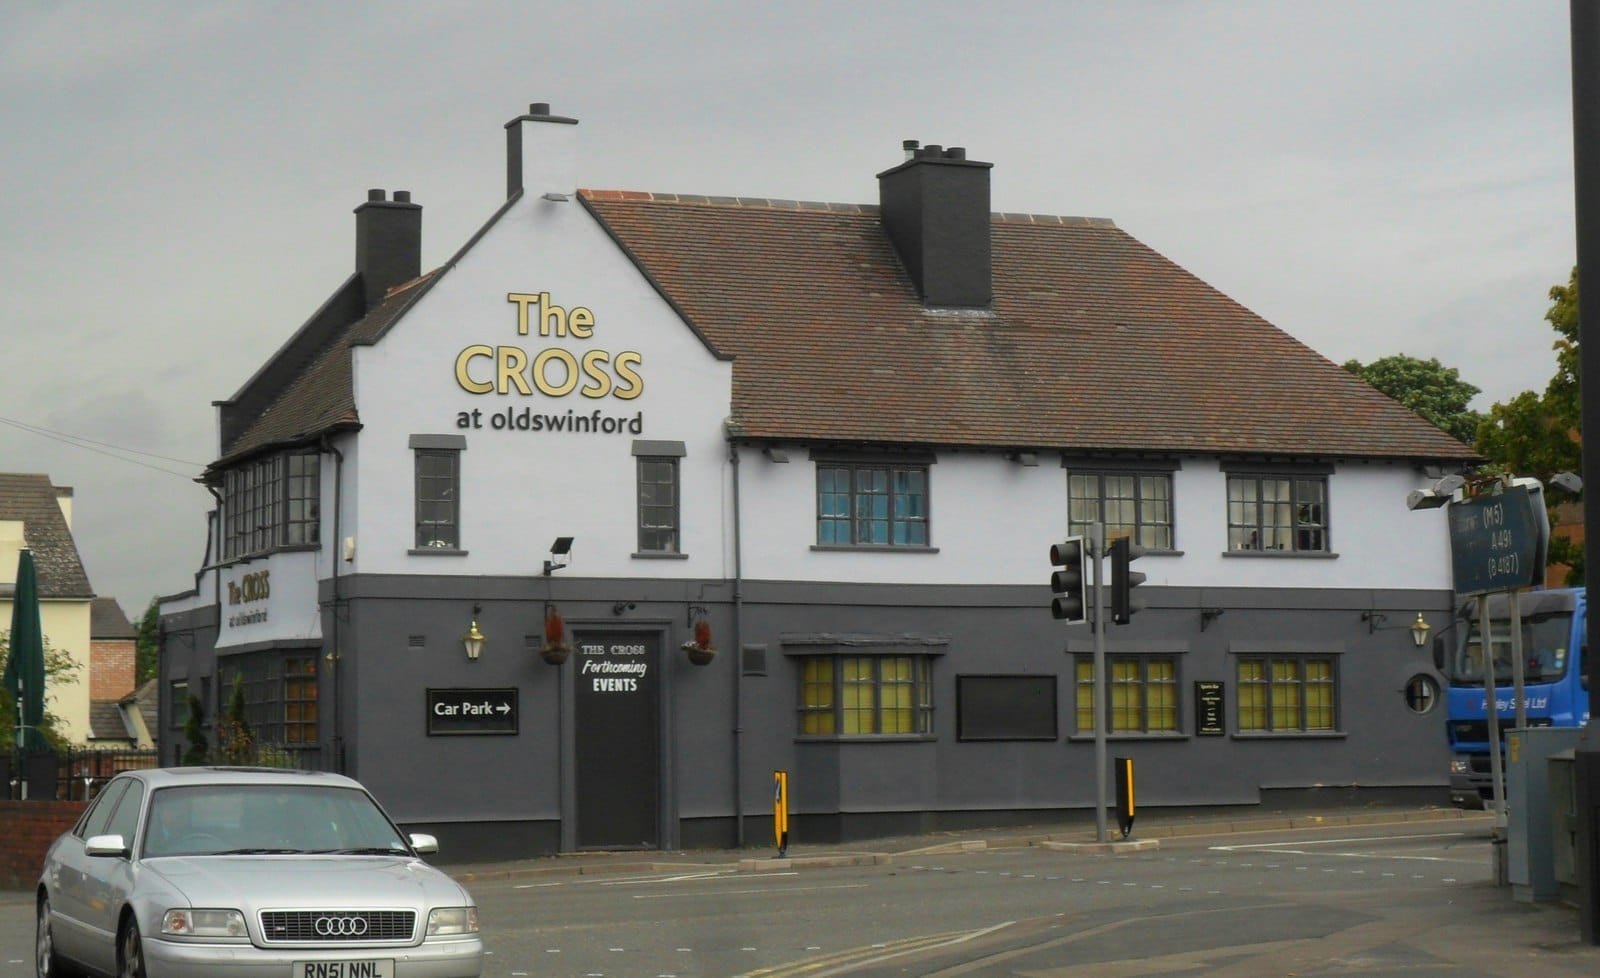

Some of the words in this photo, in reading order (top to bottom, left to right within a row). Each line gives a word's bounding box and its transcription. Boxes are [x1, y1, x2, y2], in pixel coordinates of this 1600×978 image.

[507, 291, 595, 339] The
[454, 344, 645, 400] CROSS
[456, 408, 483, 429] at
[490, 406, 643, 434] oldswinford
[581, 645, 605, 655] THE
[610, 645, 645, 655] CROSS
[581, 659, 647, 678] Forthcoming
[592, 678, 638, 692] EVENTS
[434, 702, 459, 716] Car
[462, 701, 493, 715] Park
[304, 962, 345, 978] RN51
[350, 961, 382, 978] NNL
